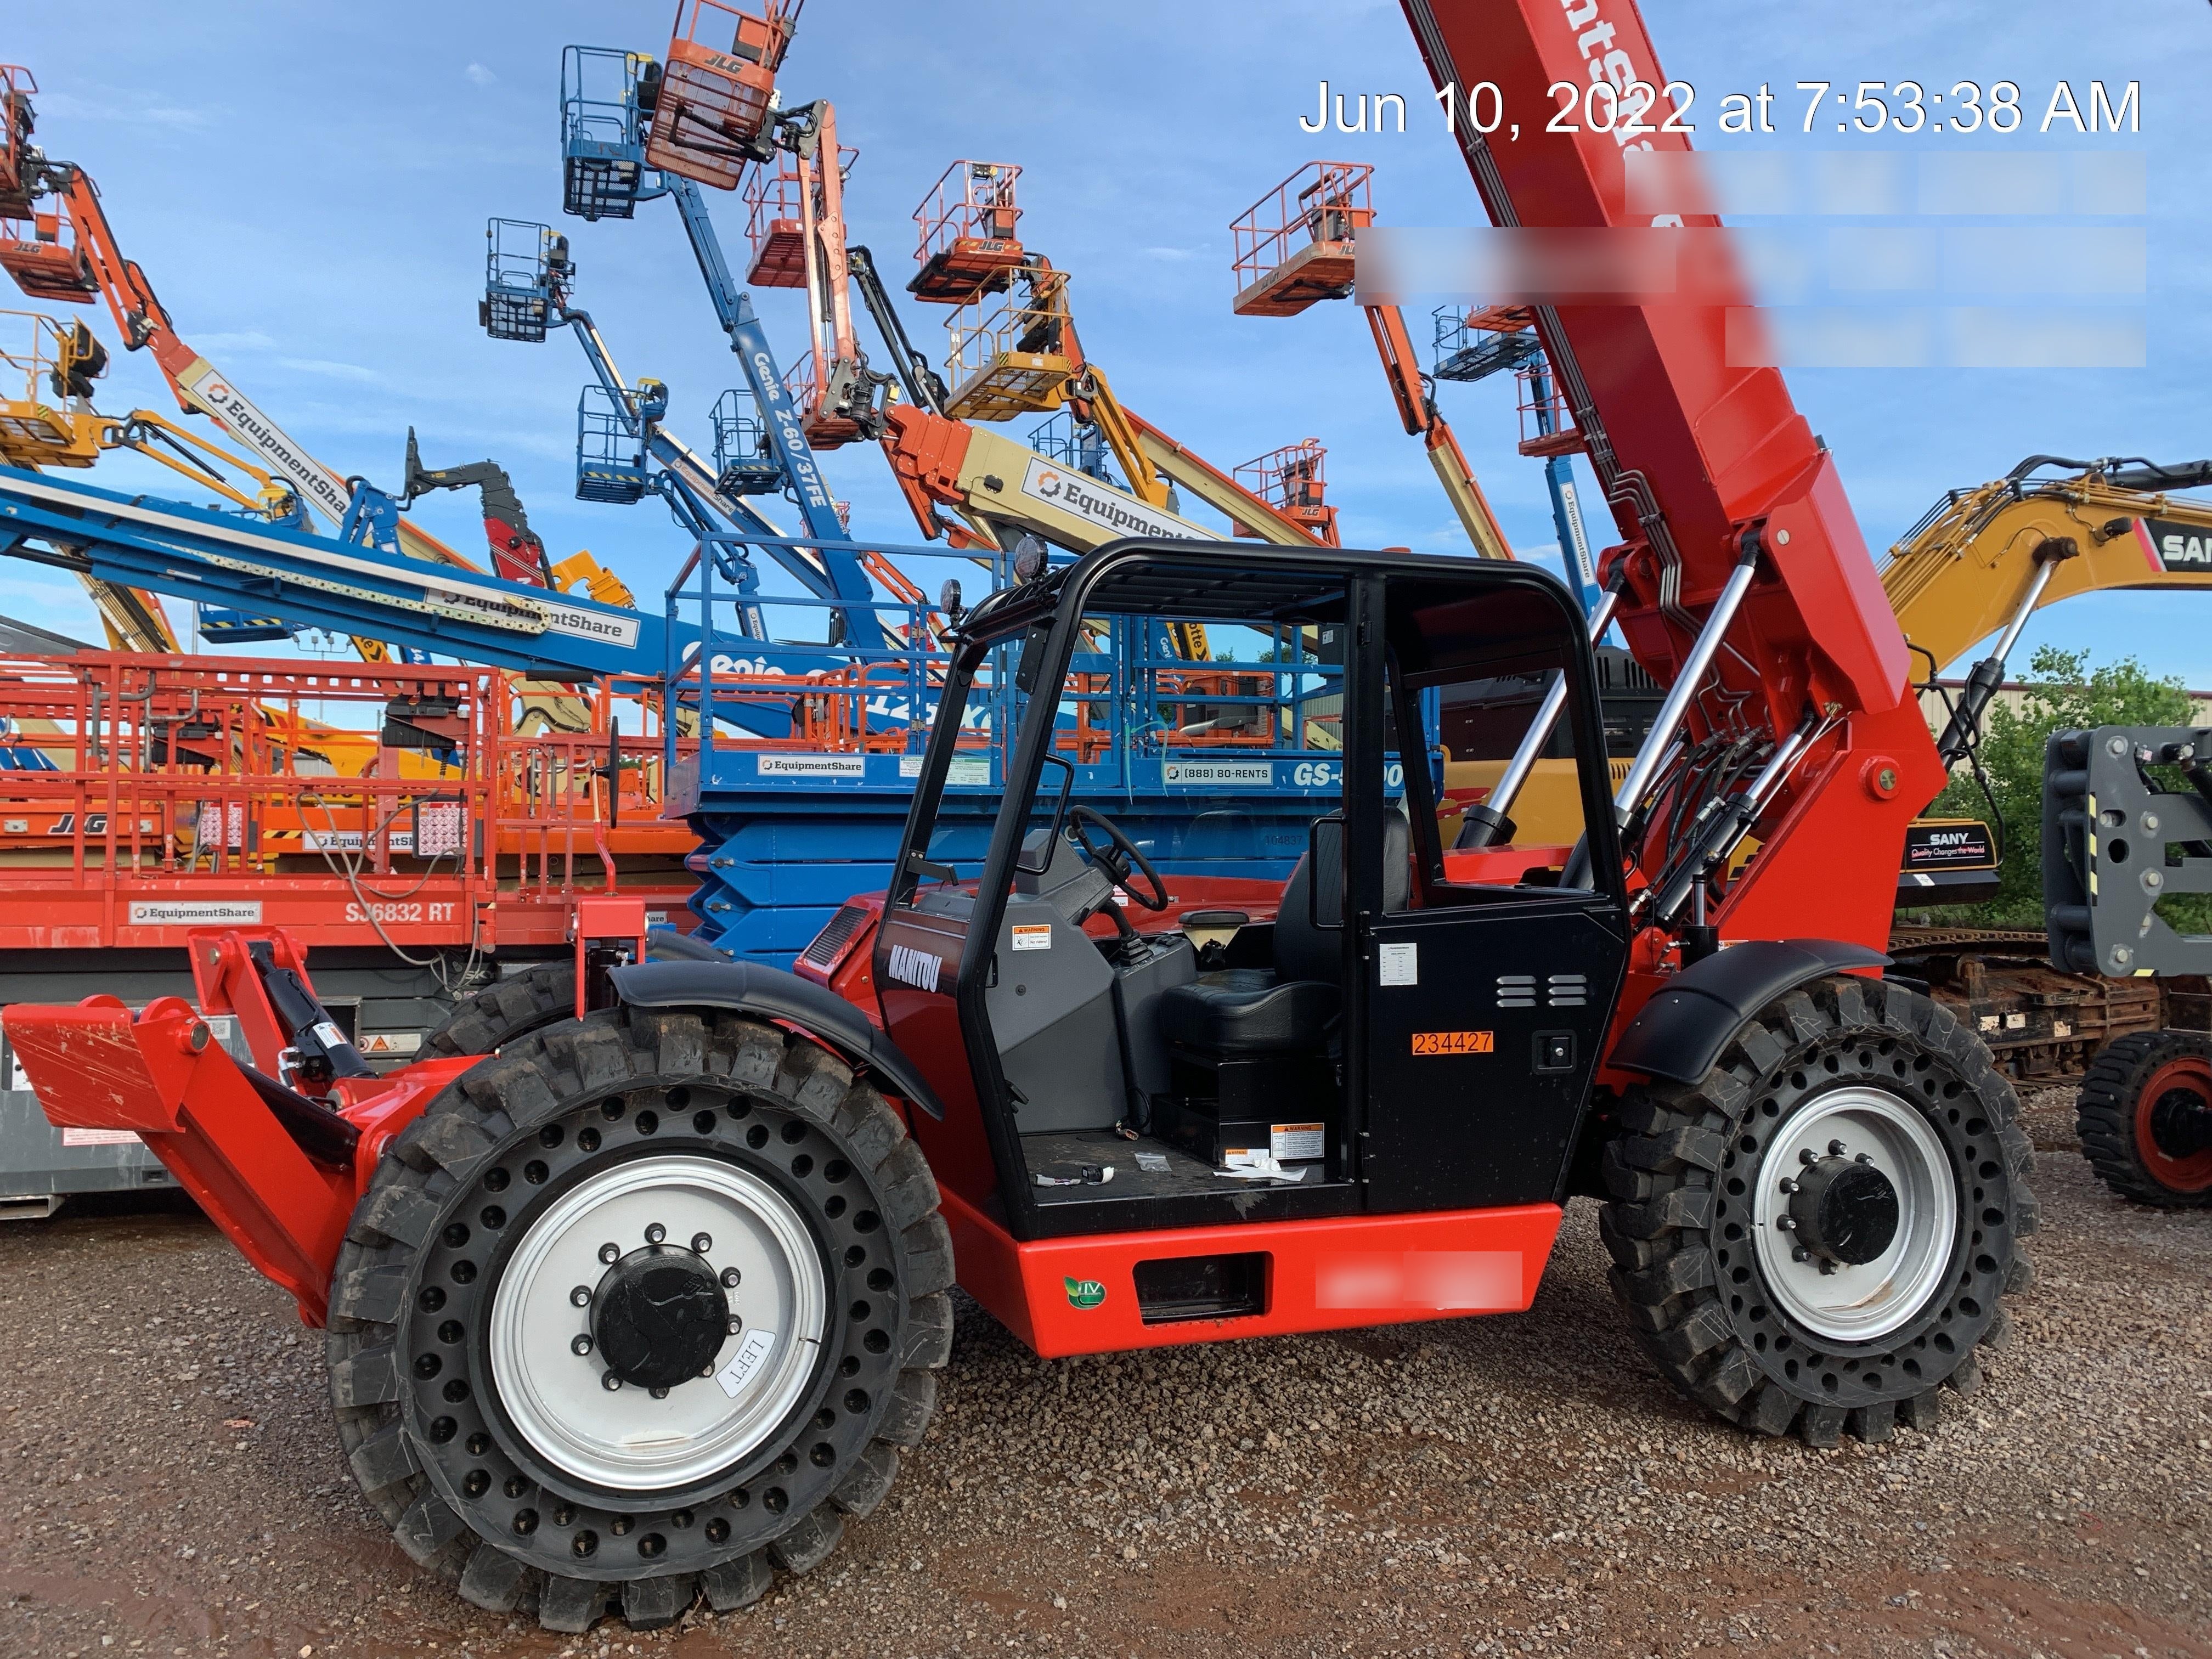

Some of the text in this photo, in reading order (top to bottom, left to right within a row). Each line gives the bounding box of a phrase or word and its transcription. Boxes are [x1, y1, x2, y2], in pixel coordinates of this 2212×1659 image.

[704, 54, 745, 74] JLG
[14, 242, 41, 253] JLG
[978, 240, 1005, 252] JLG
[754, 352, 827, 508] Genie Z-60/37FE
[225, 399, 347, 514] EquipmentSha
[1063, 482, 1195, 539] Equipmen
[1301, 508, 1320, 516] JLG
[1567, 500, 1590, 578] EquipmentShare
[1160, 637, 1173, 658] Geni
[775, 761, 862, 771] EquipmentShare
[1184, 769, 1268, 778] (888) 80-RENTS
[47, 814, 108, 834] JG
[1929, 832, 1969, 846] SANY
[1911, 848, 1932, 858] Quality
[1933, 848, 1957, 857] Changes
[1967, 845, 1985, 854] World
[149, 908, 255, 919] EquipmentShare
[345, 902, 455, 922] SJ6832 RT
[889, 945, 943, 993] MANITOU
[1414, 1032, 1492, 1053] 234427
[730, 1339, 765, 1384] LEFT
